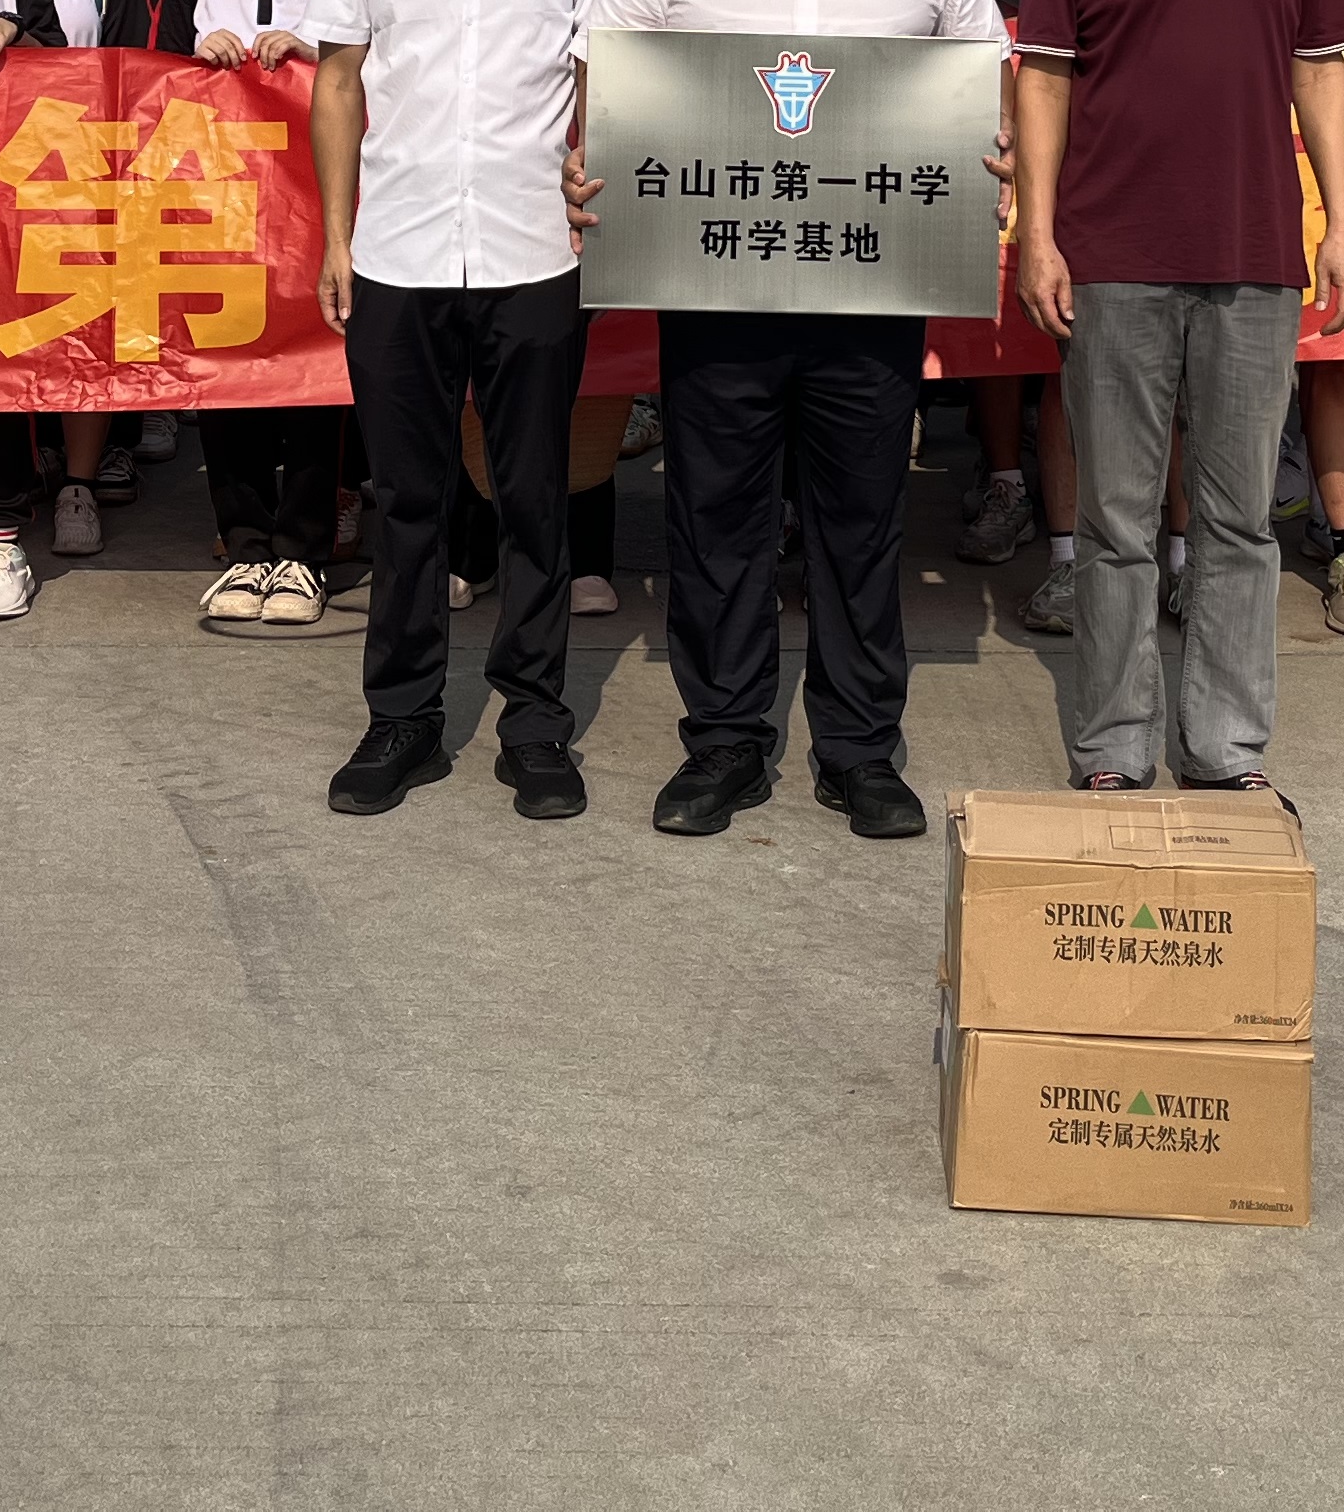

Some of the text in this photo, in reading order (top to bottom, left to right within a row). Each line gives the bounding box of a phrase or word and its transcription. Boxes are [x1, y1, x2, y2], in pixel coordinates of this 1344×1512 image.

[633, 156, 951, 205] 台山市第一中学
[699, 219, 882, 263] 研学基地
[1044, 902, 1233, 934] SPRING WATER
[1053, 934, 1224, 968] 定制专属天然泉水
[1040, 1085, 1230, 1121] SPRING WATER
[1048, 1117, 1221, 1154] 定制专属天然泉水
